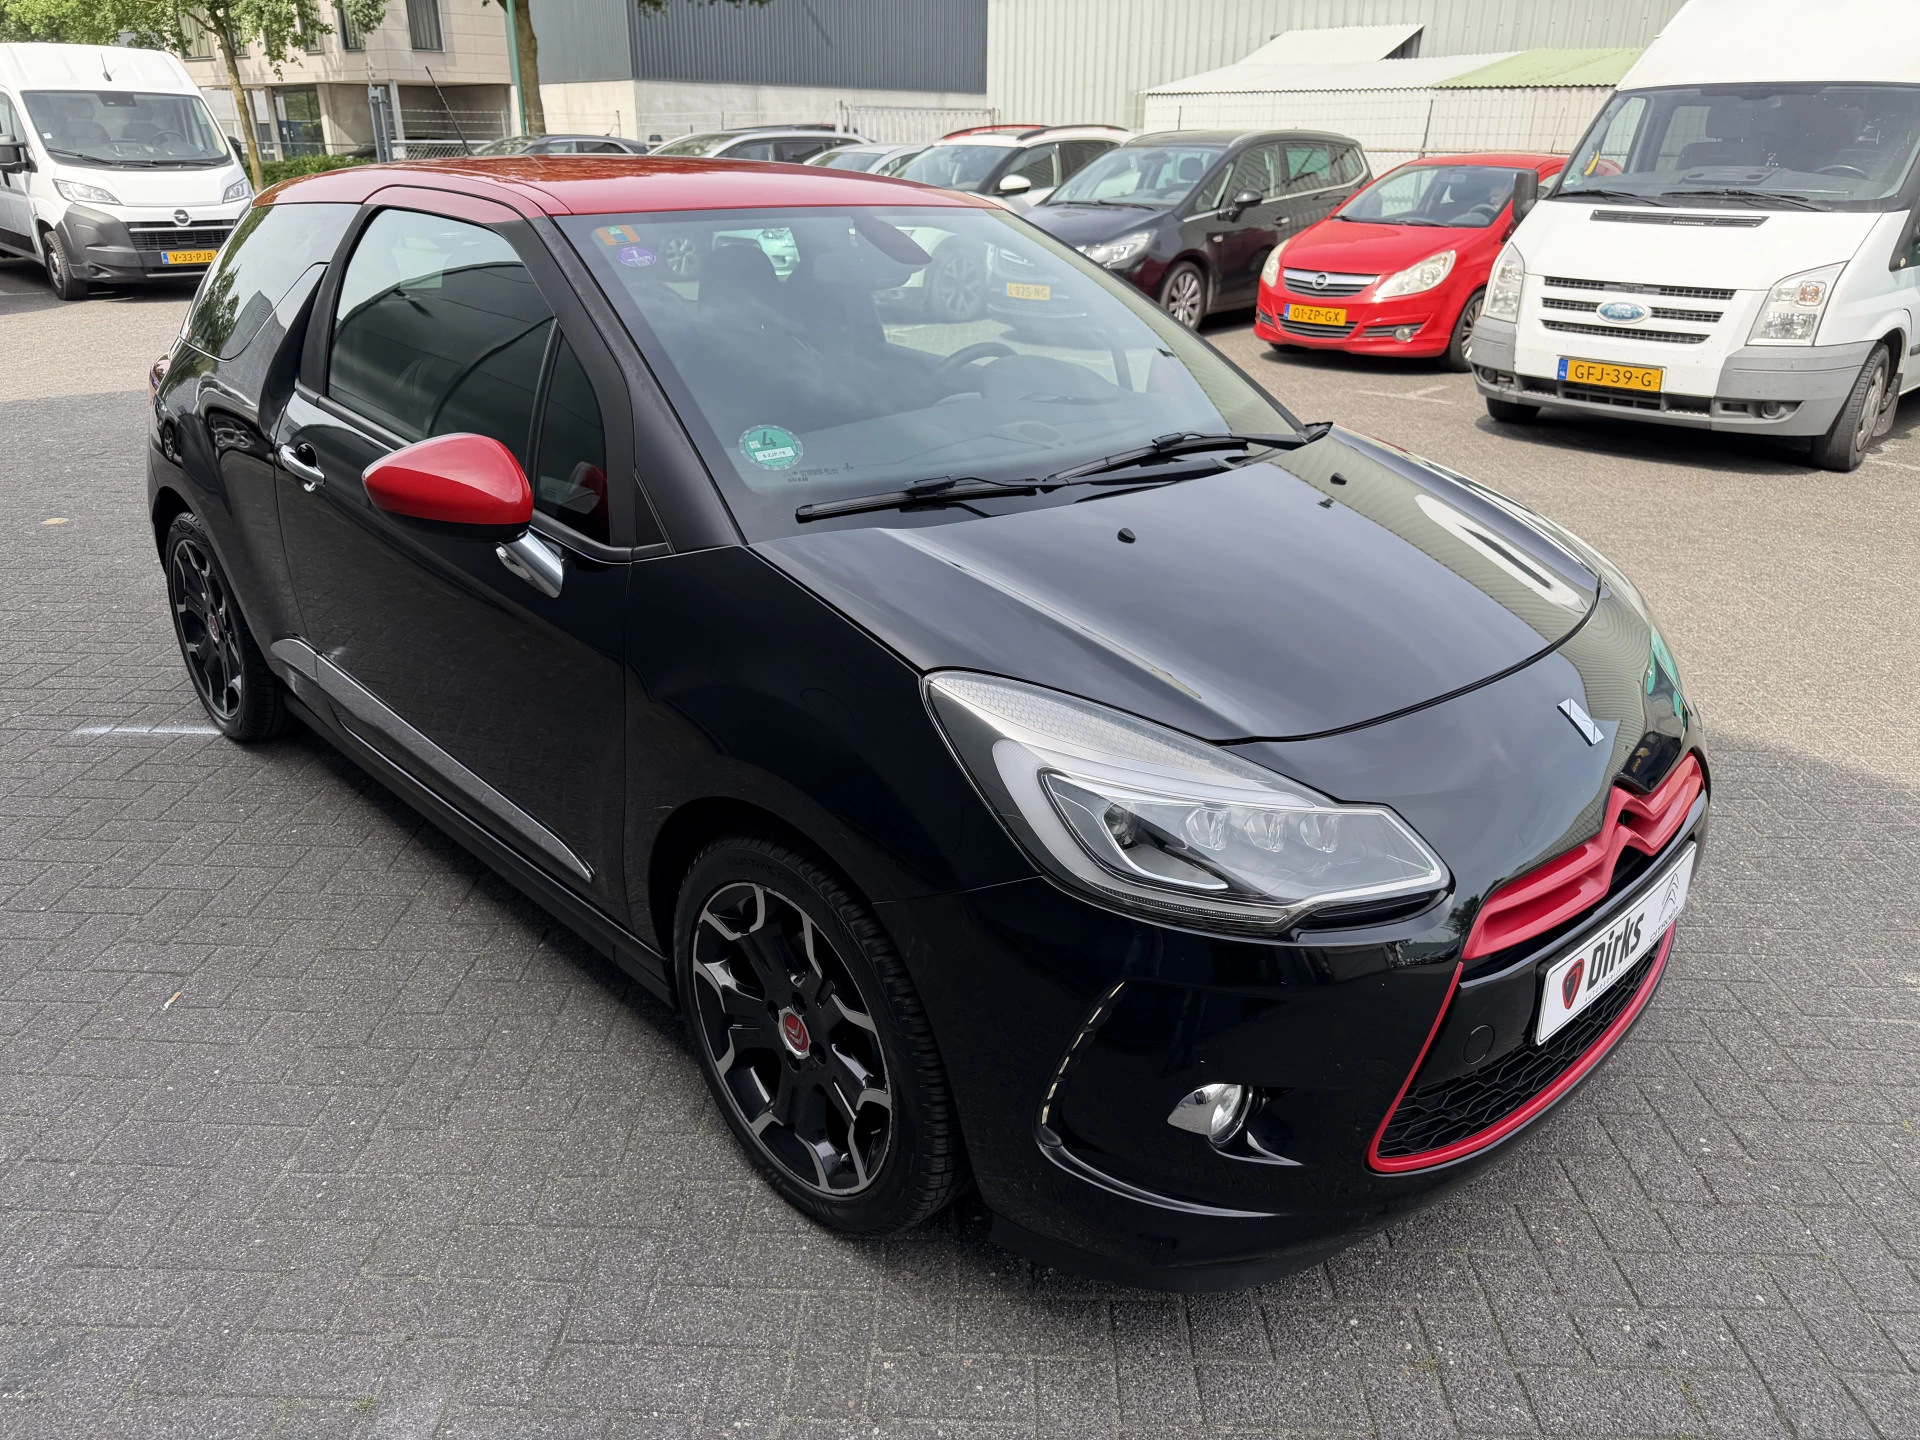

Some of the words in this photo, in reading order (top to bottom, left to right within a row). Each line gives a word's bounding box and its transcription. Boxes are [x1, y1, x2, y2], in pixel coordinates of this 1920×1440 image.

[172, 252, 213, 262] V-33-PJB
[1293, 307, 1340, 323] 01-ZP-GX
[1574, 364, 1652, 387] GFJ-39-G
[762, 431, 777, 447] 4
[1586, 912, 1645, 992] Dirks
